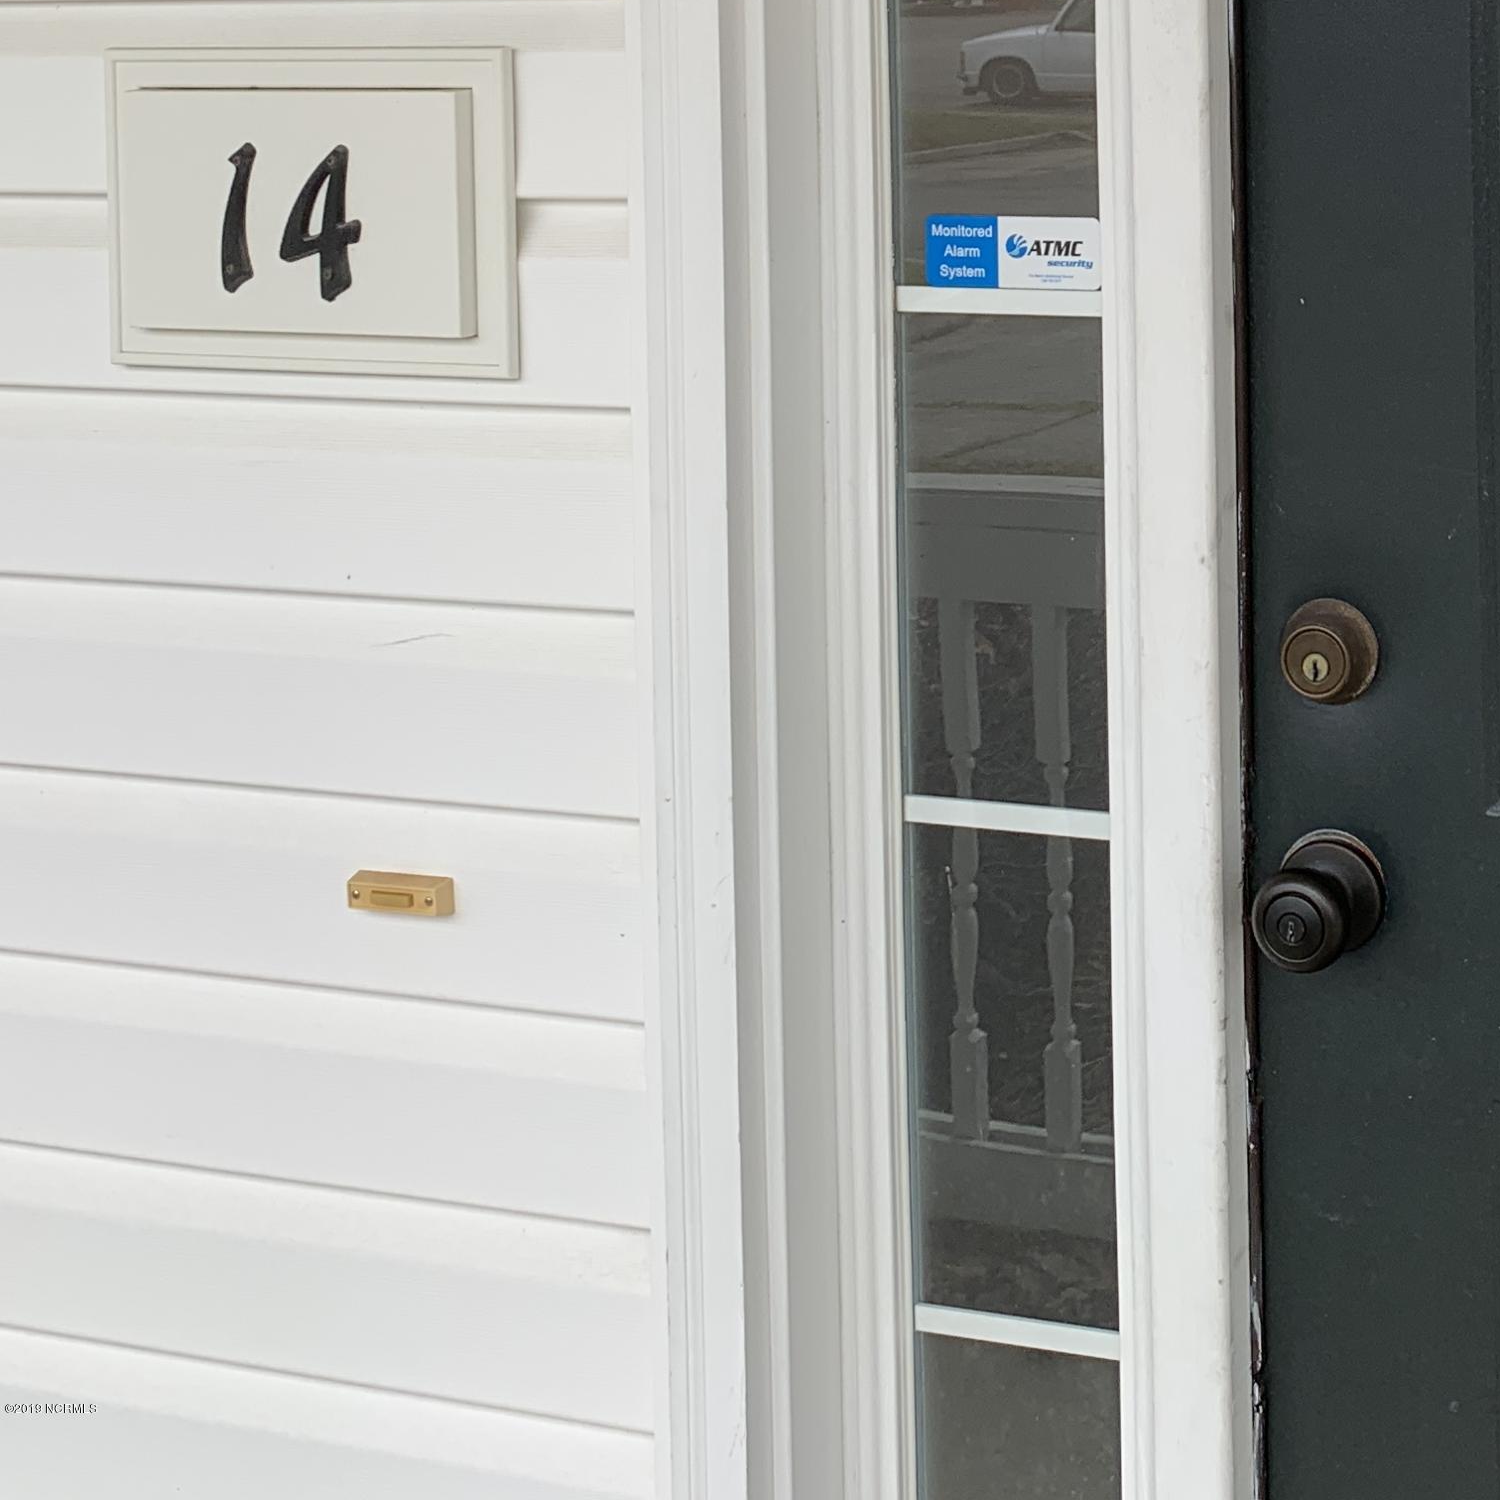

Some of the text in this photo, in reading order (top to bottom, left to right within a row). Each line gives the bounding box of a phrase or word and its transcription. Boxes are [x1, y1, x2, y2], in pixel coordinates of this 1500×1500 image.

[221, 142, 362, 303] 14
[931, 224, 993, 237] Monitored
[944, 245, 980, 257] Alarm
[1027, 240, 1083, 257] ATMC
[939, 264, 986, 279] System
[1047, 260, 1093, 269] security
